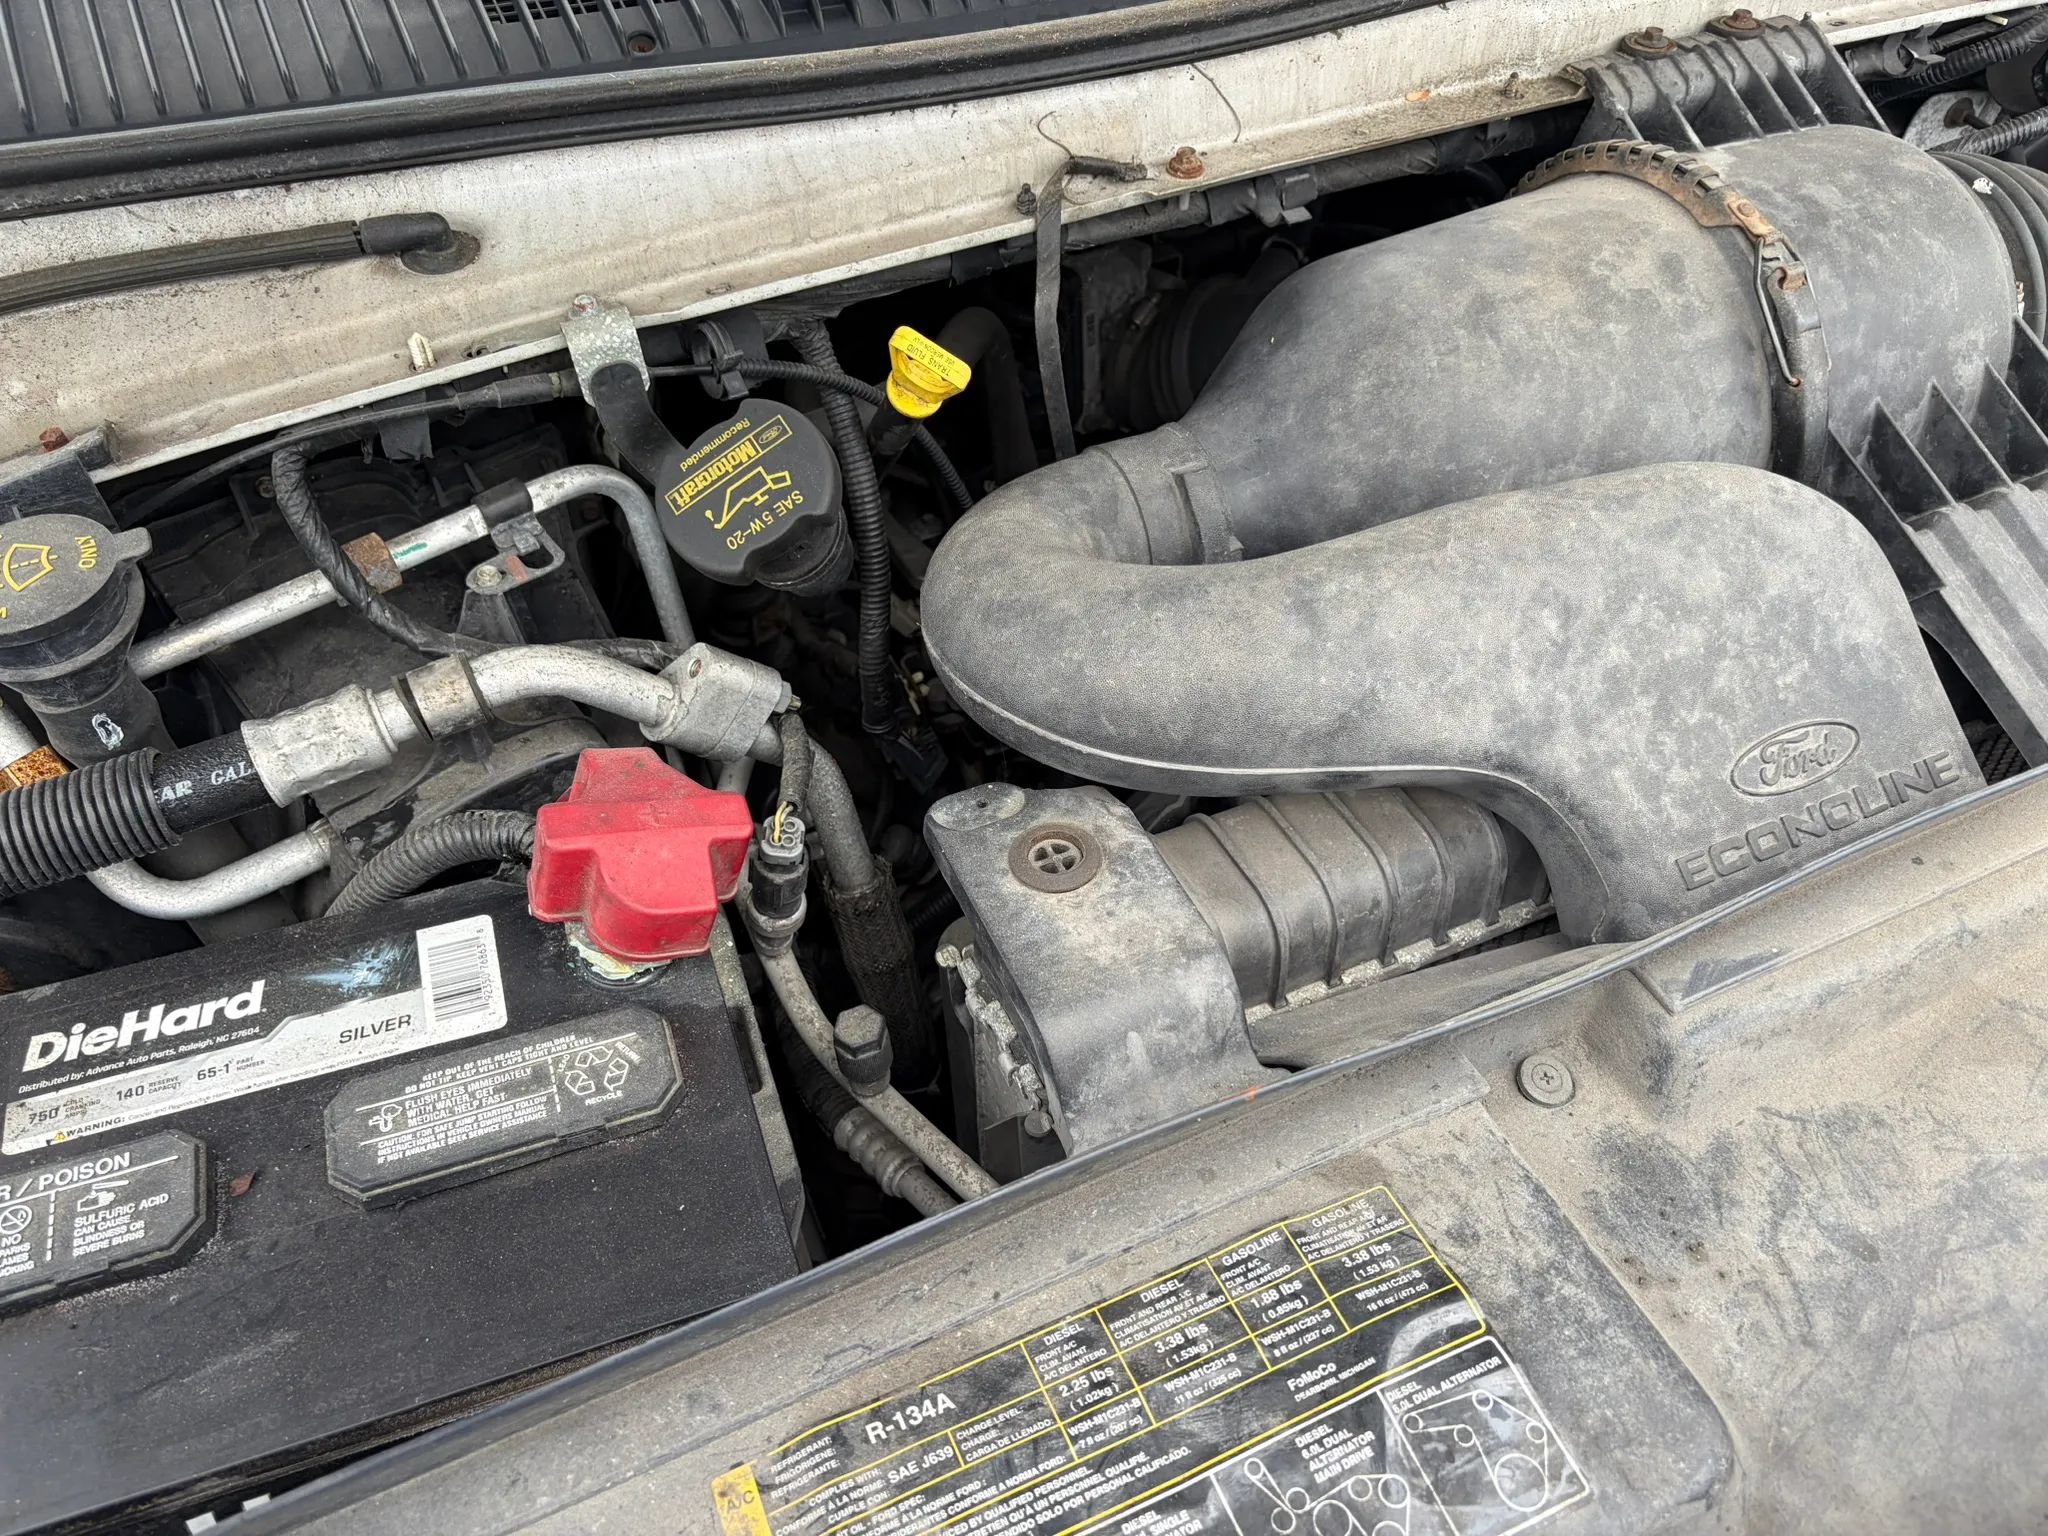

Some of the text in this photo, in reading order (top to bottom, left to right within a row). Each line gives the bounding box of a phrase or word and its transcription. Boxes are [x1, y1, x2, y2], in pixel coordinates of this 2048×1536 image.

[906, 343, 950, 376] TRANS FLUID
[680, 418, 749, 471] Recommended
[670, 441, 757, 505] Motorcraft
[773, 490, 803, 516] SAE
[74, 535, 96, 569] ONLY
[210, 761, 251, 784] GAL
[1759, 730, 1838, 787] Ford
[1675, 751, 1960, 890] ECONOLINE
[22, 979, 266, 1072] DieHard
[339, 1014, 411, 1045] SILVER
[18, 1075, 67, 1093] Distributed
[86, 1061, 124, 1075] Advance
[127, 1055, 148, 1064] Auto
[149, 1048, 176, 1059] Parts,
[215, 1033, 229, 1043] NC
[493, 1034, 575, 1061] REACH CHILDREN
[501, 1036, 593, 1066] CAPS LEVEL
[116, 1085, 144, 1100] 140
[404, 1067, 531, 1109] FLUSH EYES IMMEDIATELY
[406, 1086, 493, 1117] WITH GET
[584, 1089, 622, 1105] RECYCLE
[28, 1107, 59, 1124] 750
[66, 1116, 124, 1136] WARNING:
[407, 1108, 451, 1127] MEDICAL
[453, 1100, 479, 1114] HELP
[416, 1096, 546, 1138] FOR SAFE JUMP STARTING FOLLOW
[377, 1112, 514, 1155] INSTRUCTIONS VEHICLE OWNERS
[386, 1151, 402, 1161] NOT
[404, 1139, 445, 1156] AVAILABLE
[447, 1134, 466, 1144] SEEK
[466, 1123, 499, 1138] SERVICE
[38, 1152, 129, 1189] POISON
[73, 1215, 130, 1237] CAN CAUSE
[74, 1193, 168, 1227] SULFURIC ACID
[1311, 1198, 1368, 1227] GASOLINE
[72, 1220, 144, 1246] BLINDNESS OR
[72, 1229, 144, 1256] SEVERE BURNS
[1222, 1231, 1281, 1265] GASOLINE
[1320, 1218, 1404, 1255] DELANTERO TRASERO
[1220, 1257, 1261, 1280] FRONT A/C
[1247, 1262, 1271, 1279] AVANT
[1341, 1242, 1391, 1267] 3.38 lbs
[1140, 1279, 1183, 1302] DIESEL
[1231, 1264, 1290, 1296] A/C DELANTERO
[1250, 1279, 1302, 1307] 1.88 lbs
[1355, 1269, 1421, 1300] WSH-M1C231-B
[1109, 1295, 1177, 1331] FRONT AND REAR
[1114, 1308, 1172, 1338] CLIMATISATION
[1119, 1295, 1225, 1348] A/C DELANTERO TRASERO
[1260, 1309, 1330, 1345] WSH-M1C231-B
[1043, 1323, 1084, 1345] DIESEL
[1154, 1323, 1208, 1352] 3.38 lbs
[1034, 1340, 1076, 1363] FRONT A/C
[1043, 1348, 1106, 1381] A/C DELANTERO
[1061, 1345, 1086, 1362] AVANT
[1337, 1356, 1375, 1379] MICHIGAN
[1058, 1366, 1114, 1397] 2.25 lbs
[1163, 1352, 1236, 1391] WSH-M1C231-B
[1287, 1362, 1336, 1390] FoMoCo
[1412, 1356, 1500, 1404] DUAL ALTERNATOR
[1385, 1381, 1421, 1402] DIESEL
[865, 1393, 955, 1443] R-134A
[956, 1418, 993, 1439] CHARGE
[1067, 1397, 1141, 1435] WSH-M1C231-B
[961, 1429, 1000, 1450] CHARGE:
[965, 1418, 1053, 1461] CARGA DE LLENADO:
[1294, 1424, 1332, 1447] DIESEL
[1309, 1431, 1374, 1471] ALTERNATOR
[1322, 1428, 1352, 1448] DUAL
[769, 1436, 830, 1472] REFRIGERANT:
[774, 1448, 833, 1484] FRIGORIGENE:
[887, 1445, 953, 1483] SAE J639
[1134, 1446, 1191, 1477] CALIFICADO.
[1313, 1446, 1373, 1483] MAIN DRIVE
[770, 1459, 839, 1499] REFRIGERANTE:
[808, 1467, 881, 1506] COMPLIES WITH:
[835, 1494, 849, 1506] LA
[849, 1479, 885, 1499] NORME:
[947, 1455, 1066, 1514] CONFORME NORMA FORD:
[1033, 1497, 1049, 1511] UN
[1048, 1473, 1104, 1503] PERSONNEL
[726, 1489, 754, 1513] A/C
[827, 1491, 887, 1523] CUMPLE CON:
[922, 1480, 981, 1513] NORME FORD
[968, 1466, 1092, 1528] BY QUALIFIED PERSONNEL.
[1035, 1473, 1134, 1523] SOLO POR PERSONAL
[849, 1522, 866, 1534] OIL
[871, 1506, 898, 1524] FORD
[899, 1494, 925, 1511] SPEC:
[1121, 1510, 1161, 1535] DIESEL
[1149, 1509, 1189, 1535] SINGLE
